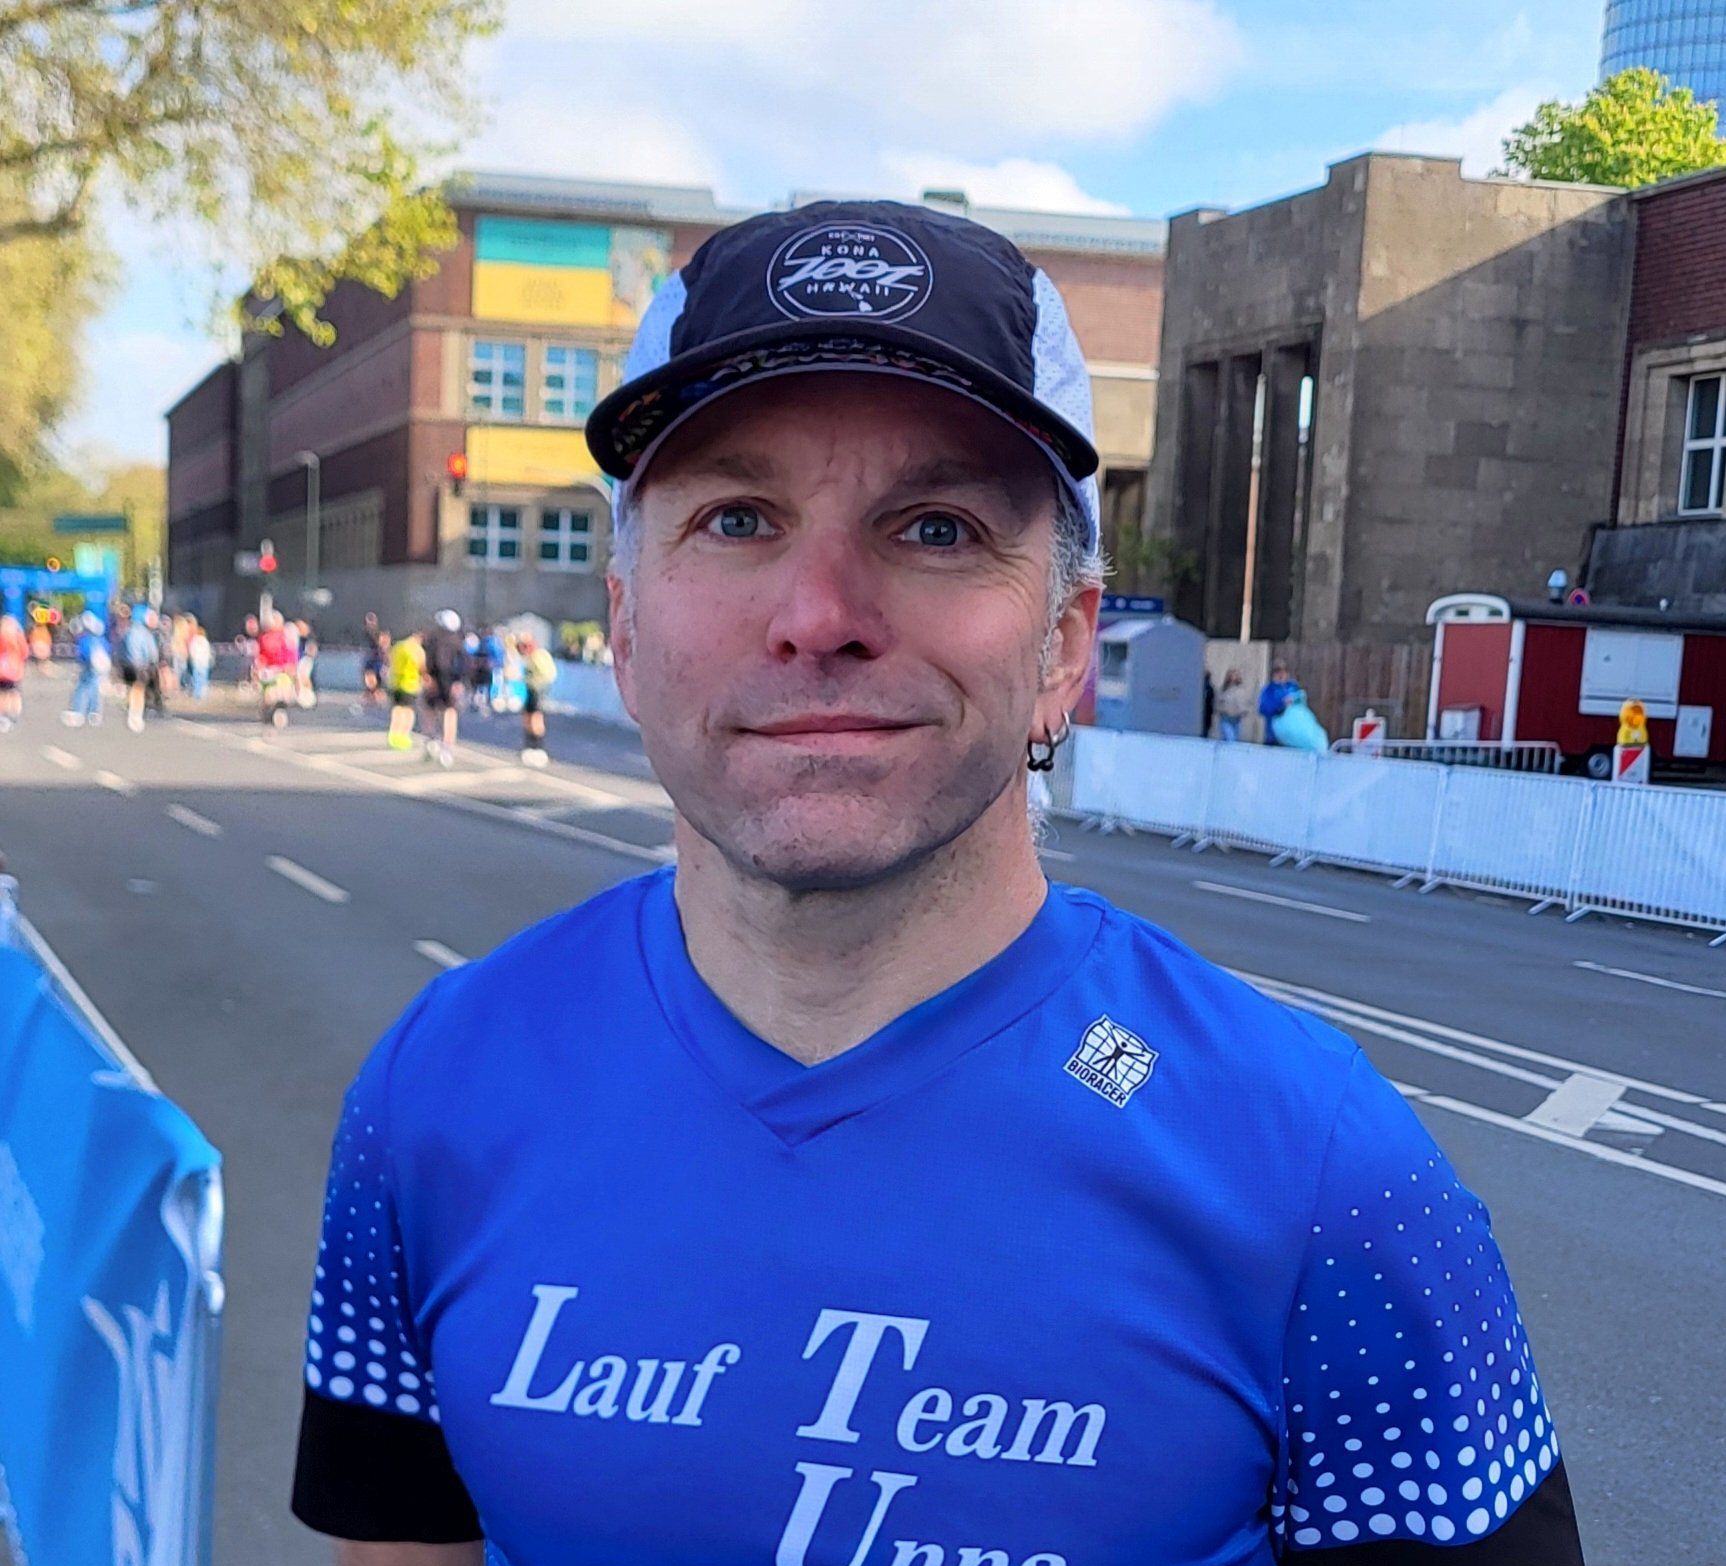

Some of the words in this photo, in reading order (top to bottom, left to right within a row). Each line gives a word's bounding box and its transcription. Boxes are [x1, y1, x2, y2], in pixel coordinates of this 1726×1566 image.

[821, 244, 880, 258] KONA
[806, 281, 890, 297] HAWAII
[1067, 1060, 1127, 1106] BIORACER
[490, 1283, 742, 1427] Lauf
[795, 1308, 1107, 1467] Team
